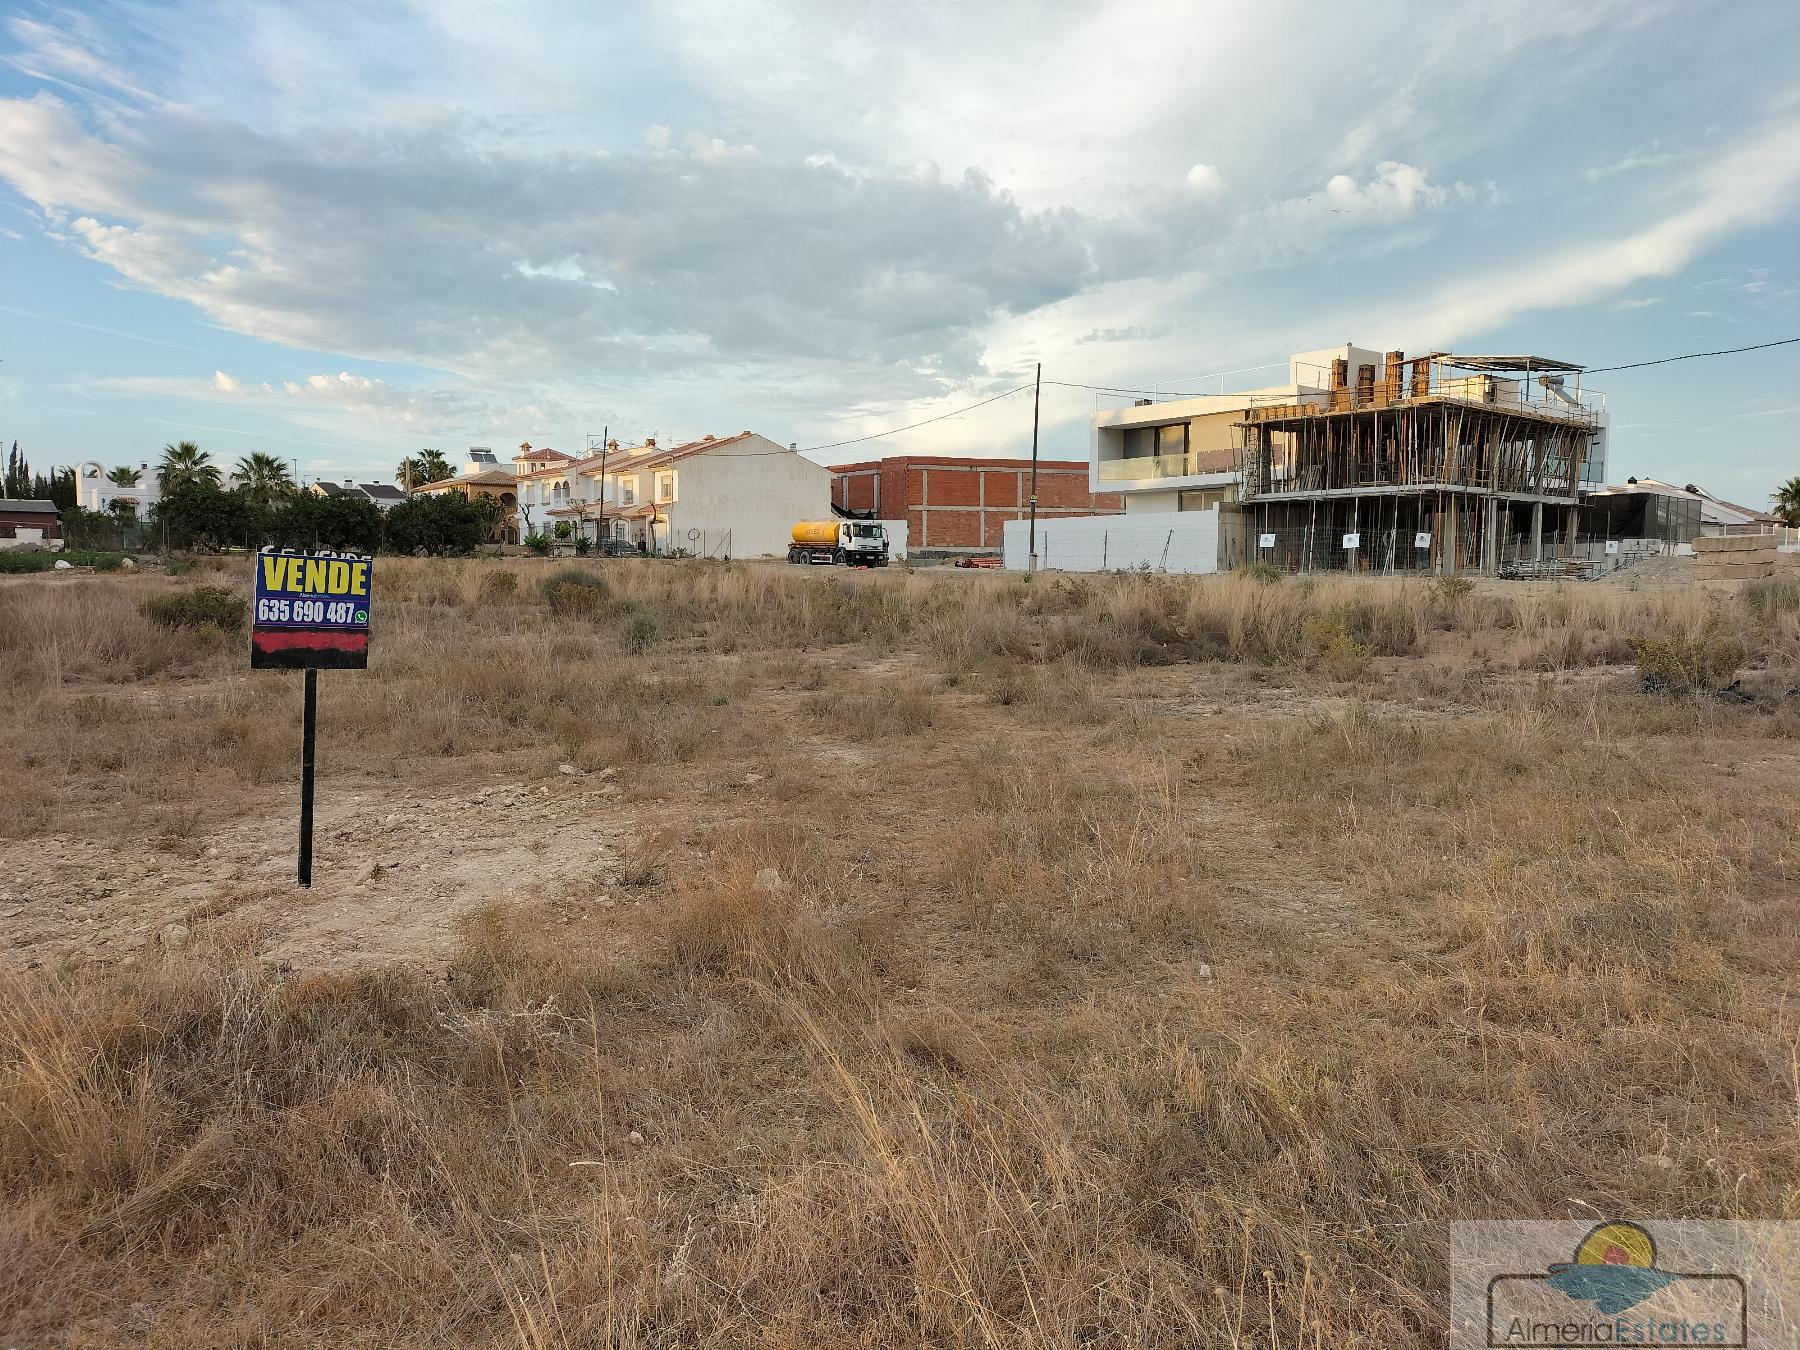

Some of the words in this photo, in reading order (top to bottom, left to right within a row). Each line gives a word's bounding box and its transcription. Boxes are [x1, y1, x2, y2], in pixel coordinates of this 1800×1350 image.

[264, 557, 367, 595] VENDE
[258, 599, 290, 621] 635
[293, 601, 324, 622] 690
[327, 602, 355, 624] 487
